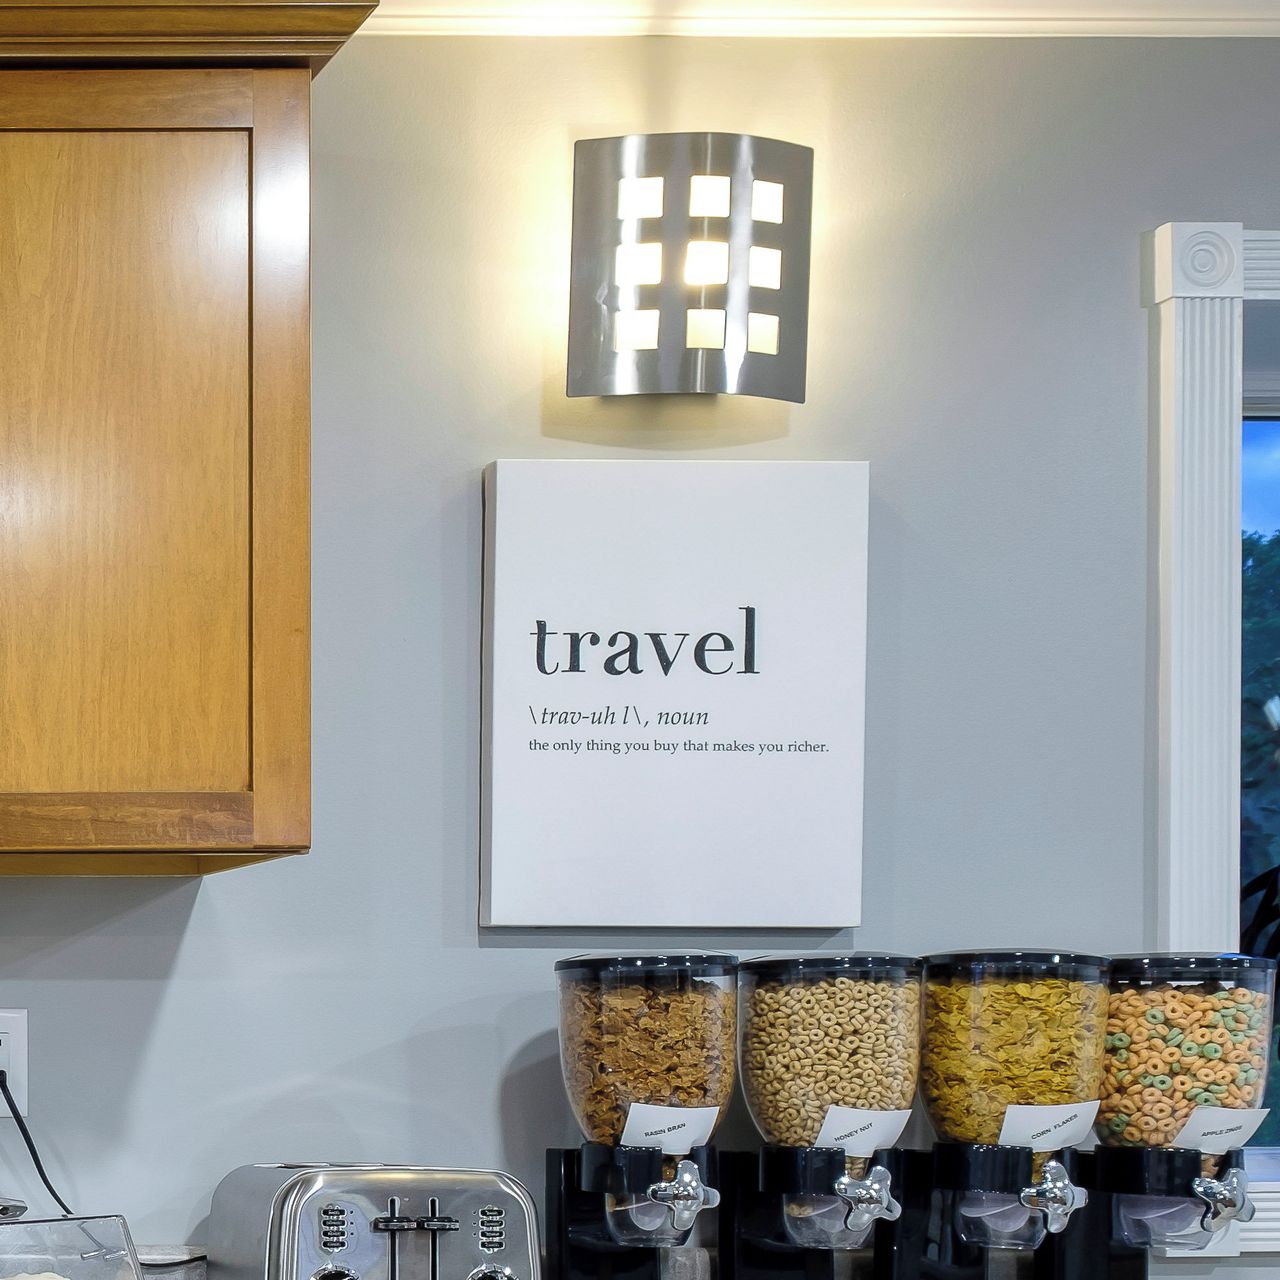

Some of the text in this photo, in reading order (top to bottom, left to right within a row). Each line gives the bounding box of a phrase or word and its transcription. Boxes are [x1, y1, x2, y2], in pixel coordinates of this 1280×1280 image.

[529, 605, 761, 677] travel
[657, 711, 709, 726] noun
[529, 739, 830, 756] the only thing you buy that makes you richer.
[666, 1122, 686, 1133] BRAN
[833, 1122, 873, 1142] HONEY NUT
[1031, 1113, 1079, 1140] CORN FLAKES
[1201, 1129, 1225, 1137] APPLE
